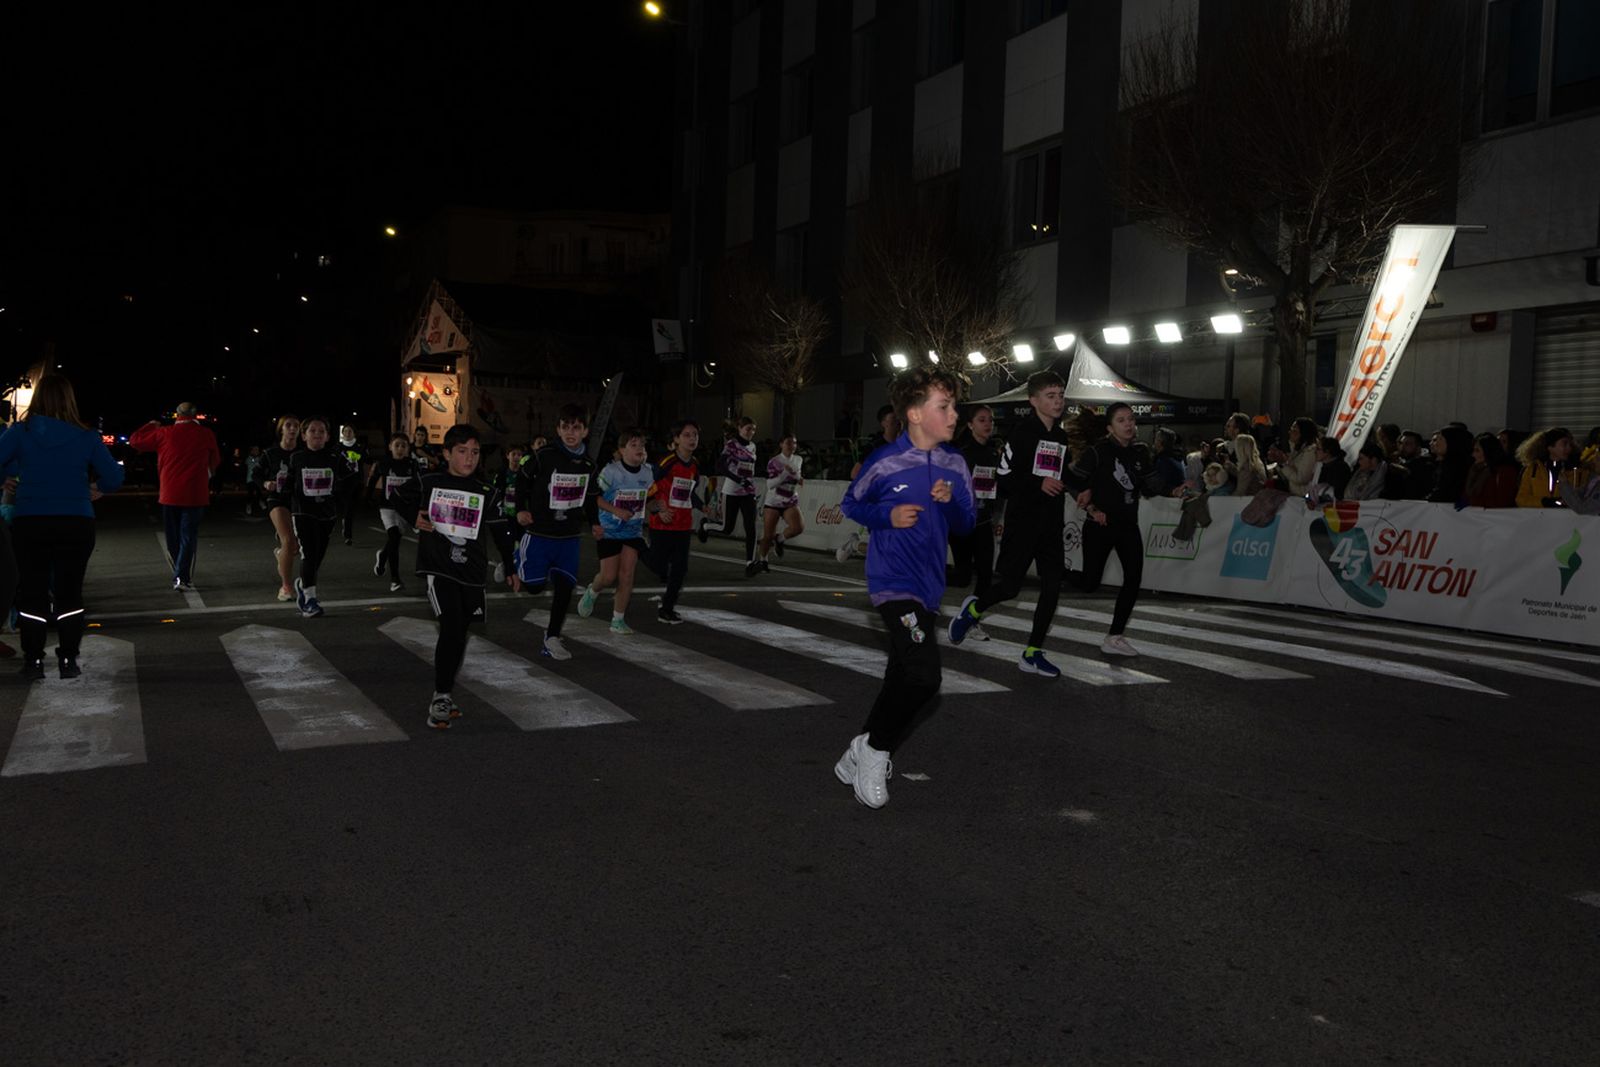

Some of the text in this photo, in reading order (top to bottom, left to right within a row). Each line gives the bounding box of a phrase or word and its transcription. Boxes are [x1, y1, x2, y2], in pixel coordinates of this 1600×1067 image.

[1352, 391, 1379, 438] obras
[1150, 534, 1195, 550] ALISA
[1231, 537, 1270, 557] alsa
[1374, 528, 1439, 560] SAN
[1329, 537, 1368, 581] 43
[1367, 558, 1477, 598] ANTÓN
[1521, 598, 1553, 608] Patronato
[1554, 601, 1587, 611] Municipal
[1528, 607, 1557, 616] Deportes
